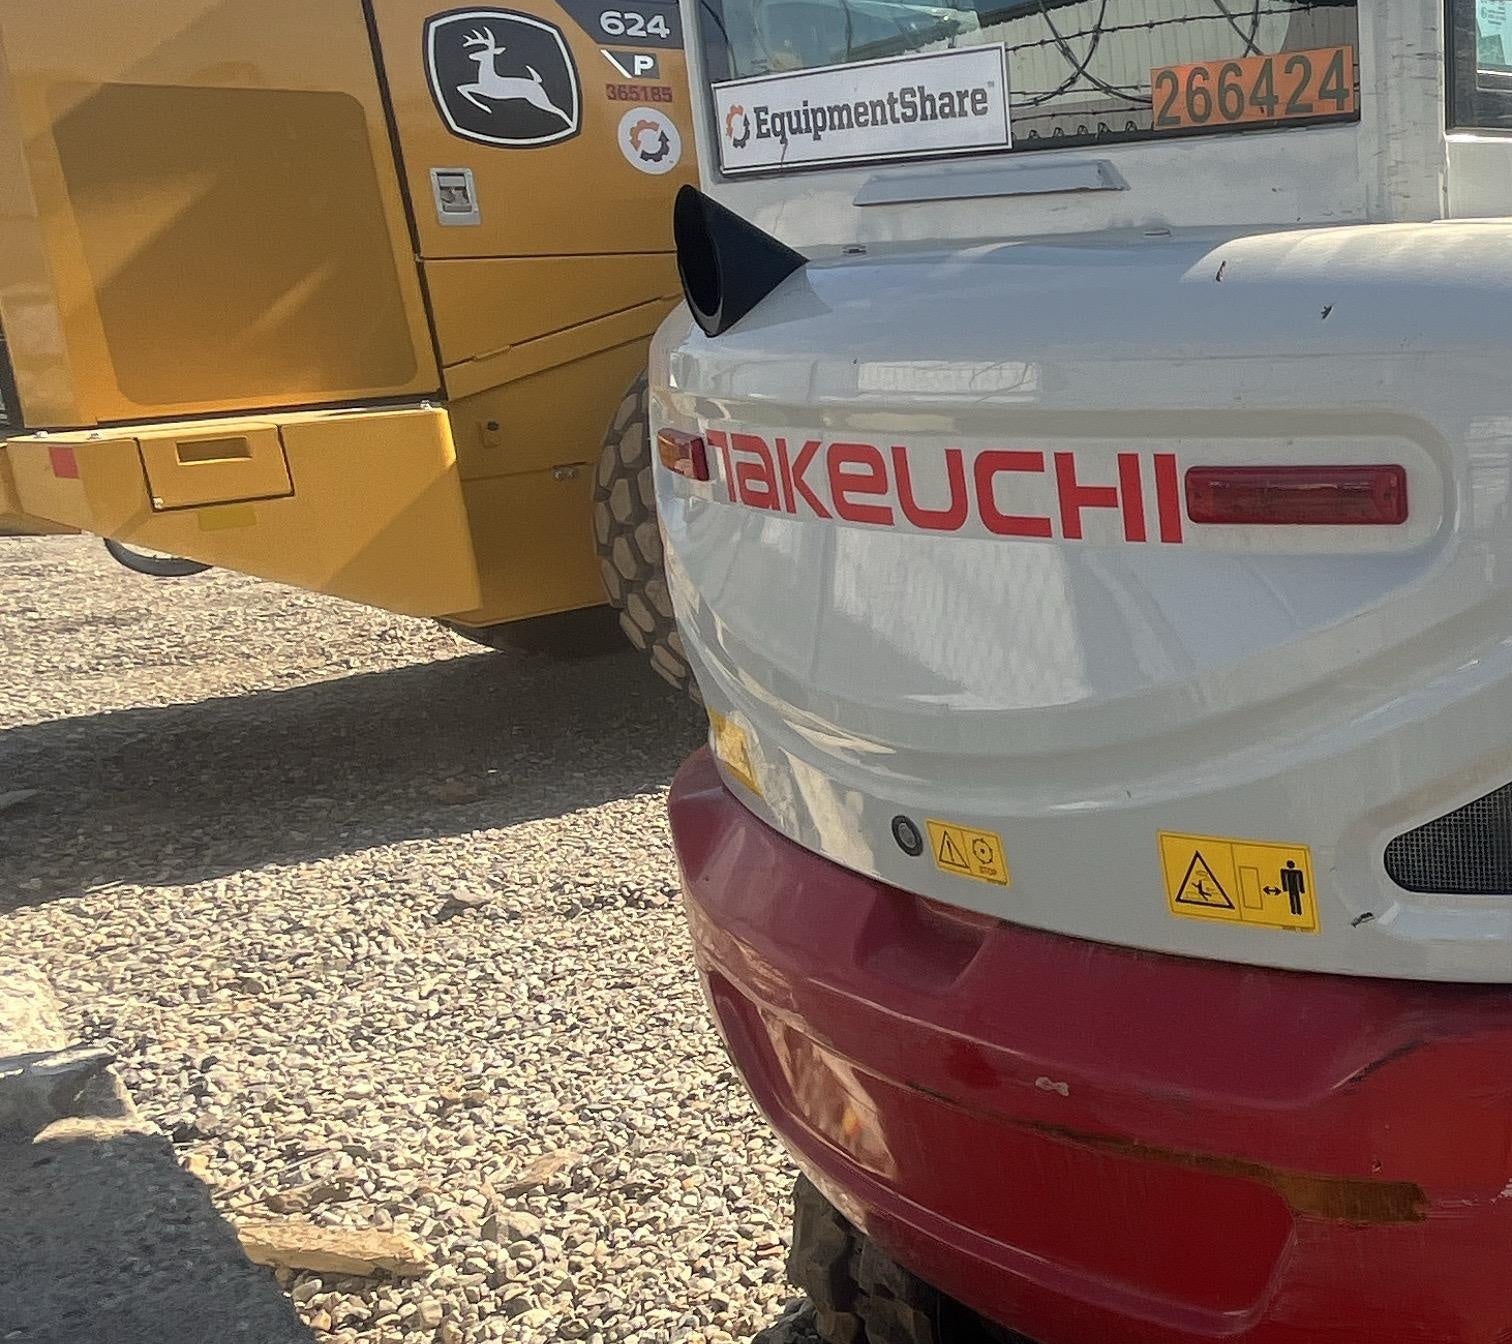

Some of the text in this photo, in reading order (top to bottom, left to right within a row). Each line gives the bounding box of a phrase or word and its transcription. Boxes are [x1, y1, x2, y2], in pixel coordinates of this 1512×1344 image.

[600, 10, 670, 38] 624
[634, 55, 654, 76] P
[606, 84, 672, 103] 365185
[1155, 50, 1350, 127] 266424
[753, 84, 988, 144] EquipmentShare
